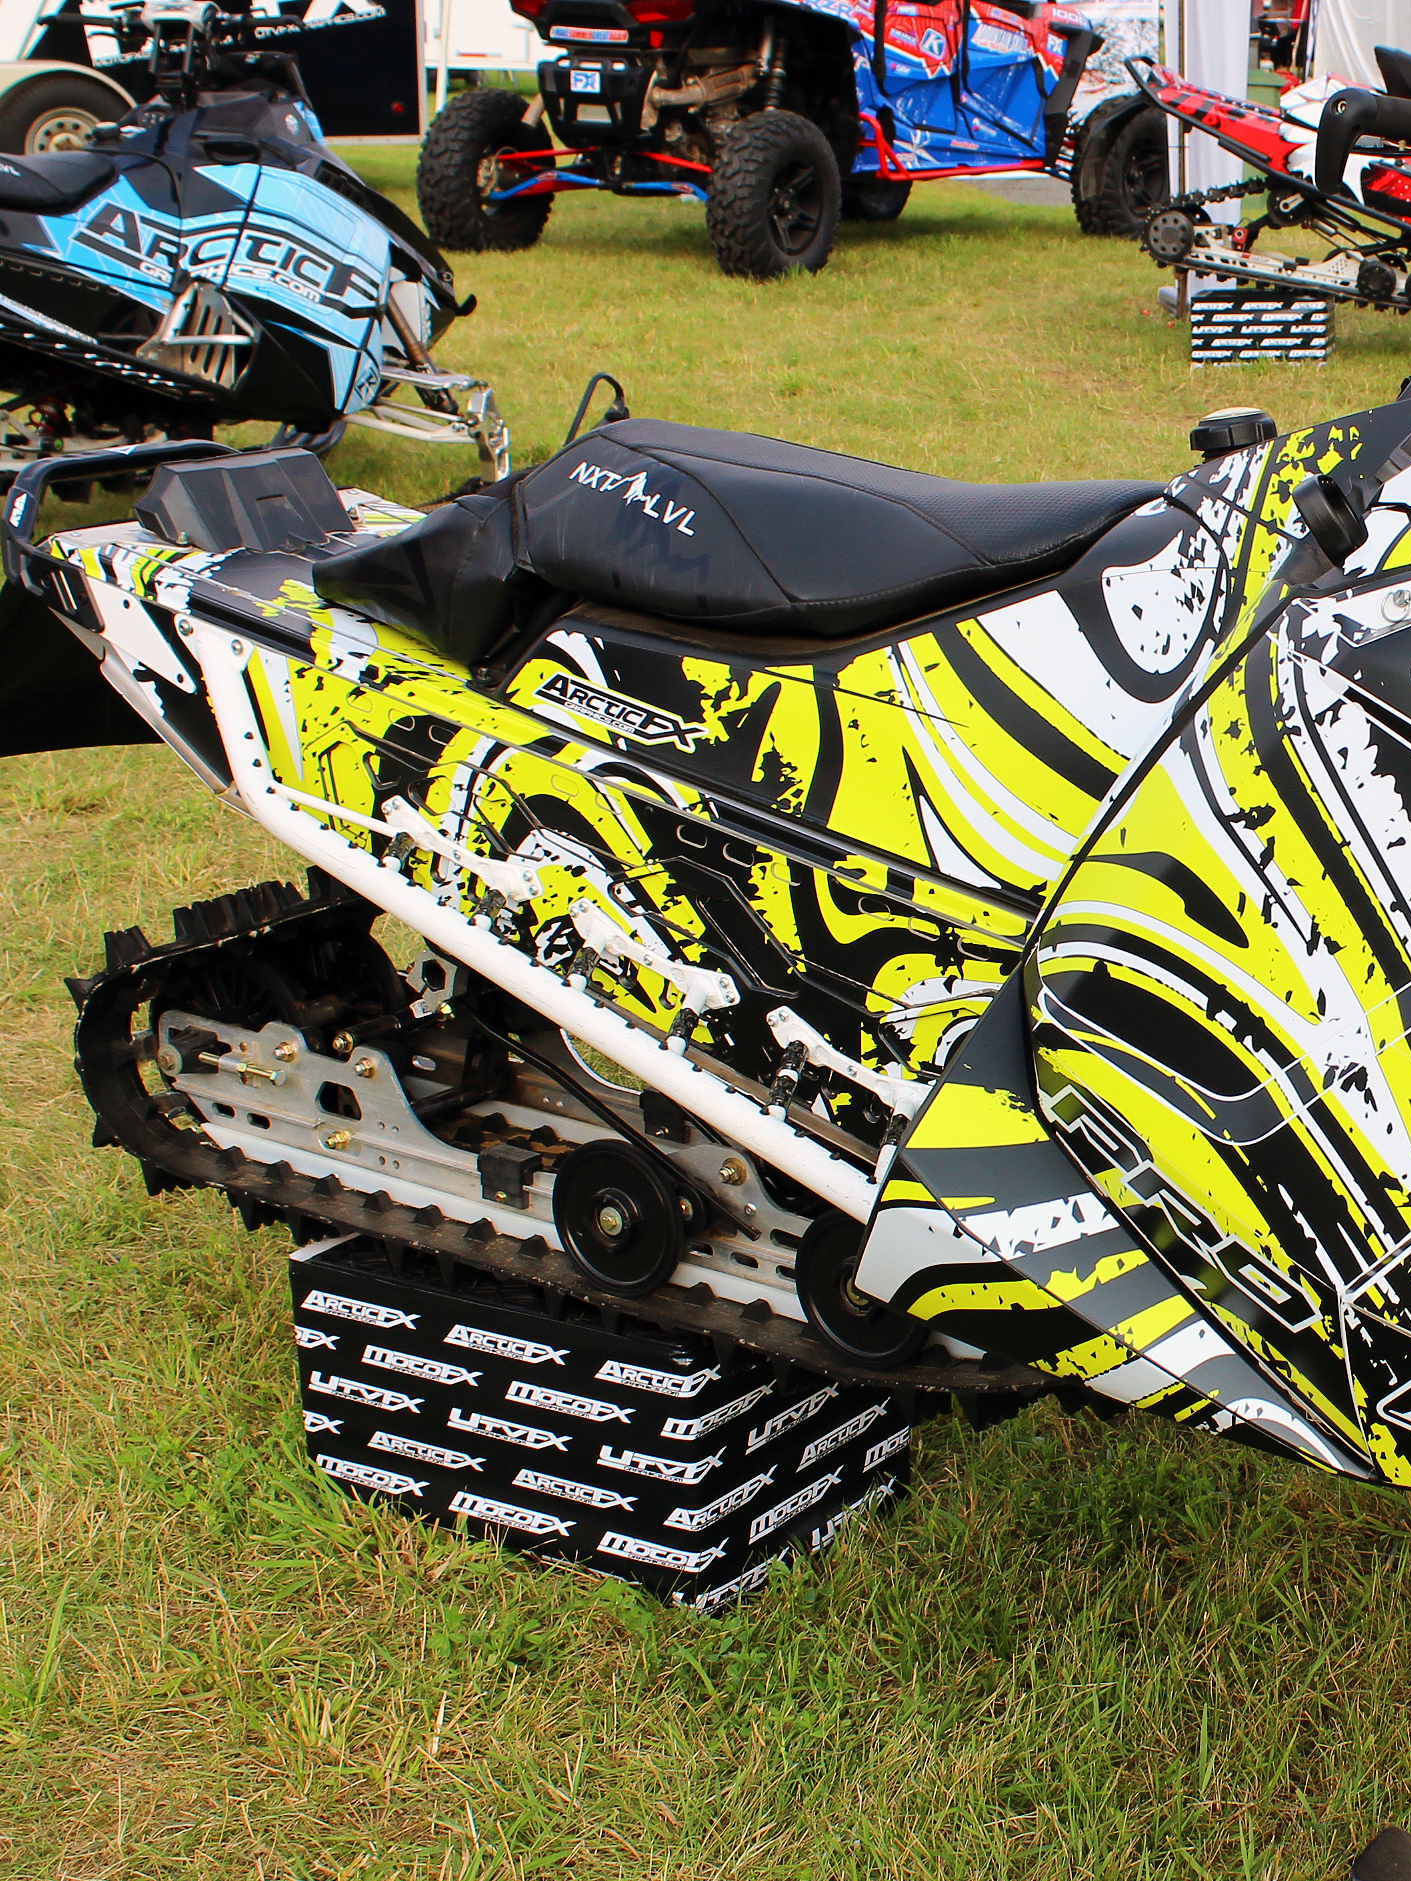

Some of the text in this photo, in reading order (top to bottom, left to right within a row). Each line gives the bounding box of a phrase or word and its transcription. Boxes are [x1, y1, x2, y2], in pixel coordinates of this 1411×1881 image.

[569, 461, 623, 492] NXT
[534, 672, 709, 752] ARCTICFX
[301, 1290, 421, 1330] ARCTICFX
[361, 1345, 483, 1386] MOTOFX
[443, 1324, 571, 1365] ARCTICFX
[308, 1370, 425, 1414] UTVFX
[594, 1360, 721, 1397] ARCTICFX
[505, 1380, 636, 1424] MOTOFX
[745, 1382, 839, 1455] UTVFX
[367, 1430, 487, 1471] ARCTICFX
[447, 1407, 573, 1451] UTVFX
[796, 1396, 891, 1473] ARCTICFX
[316, 1453, 430, 1496] MOTOFX
[597, 1444, 727, 1484] UTVFX
[512, 1468, 638, 1511] ARCTICFX
[663, 1464, 778, 1531] ARCTICFX
[749, 1464, 844, 1545] MOTOFX
[448, 1491, 577, 1536] MOTOFX
[597, 1531, 729, 1573] MOTOFX
